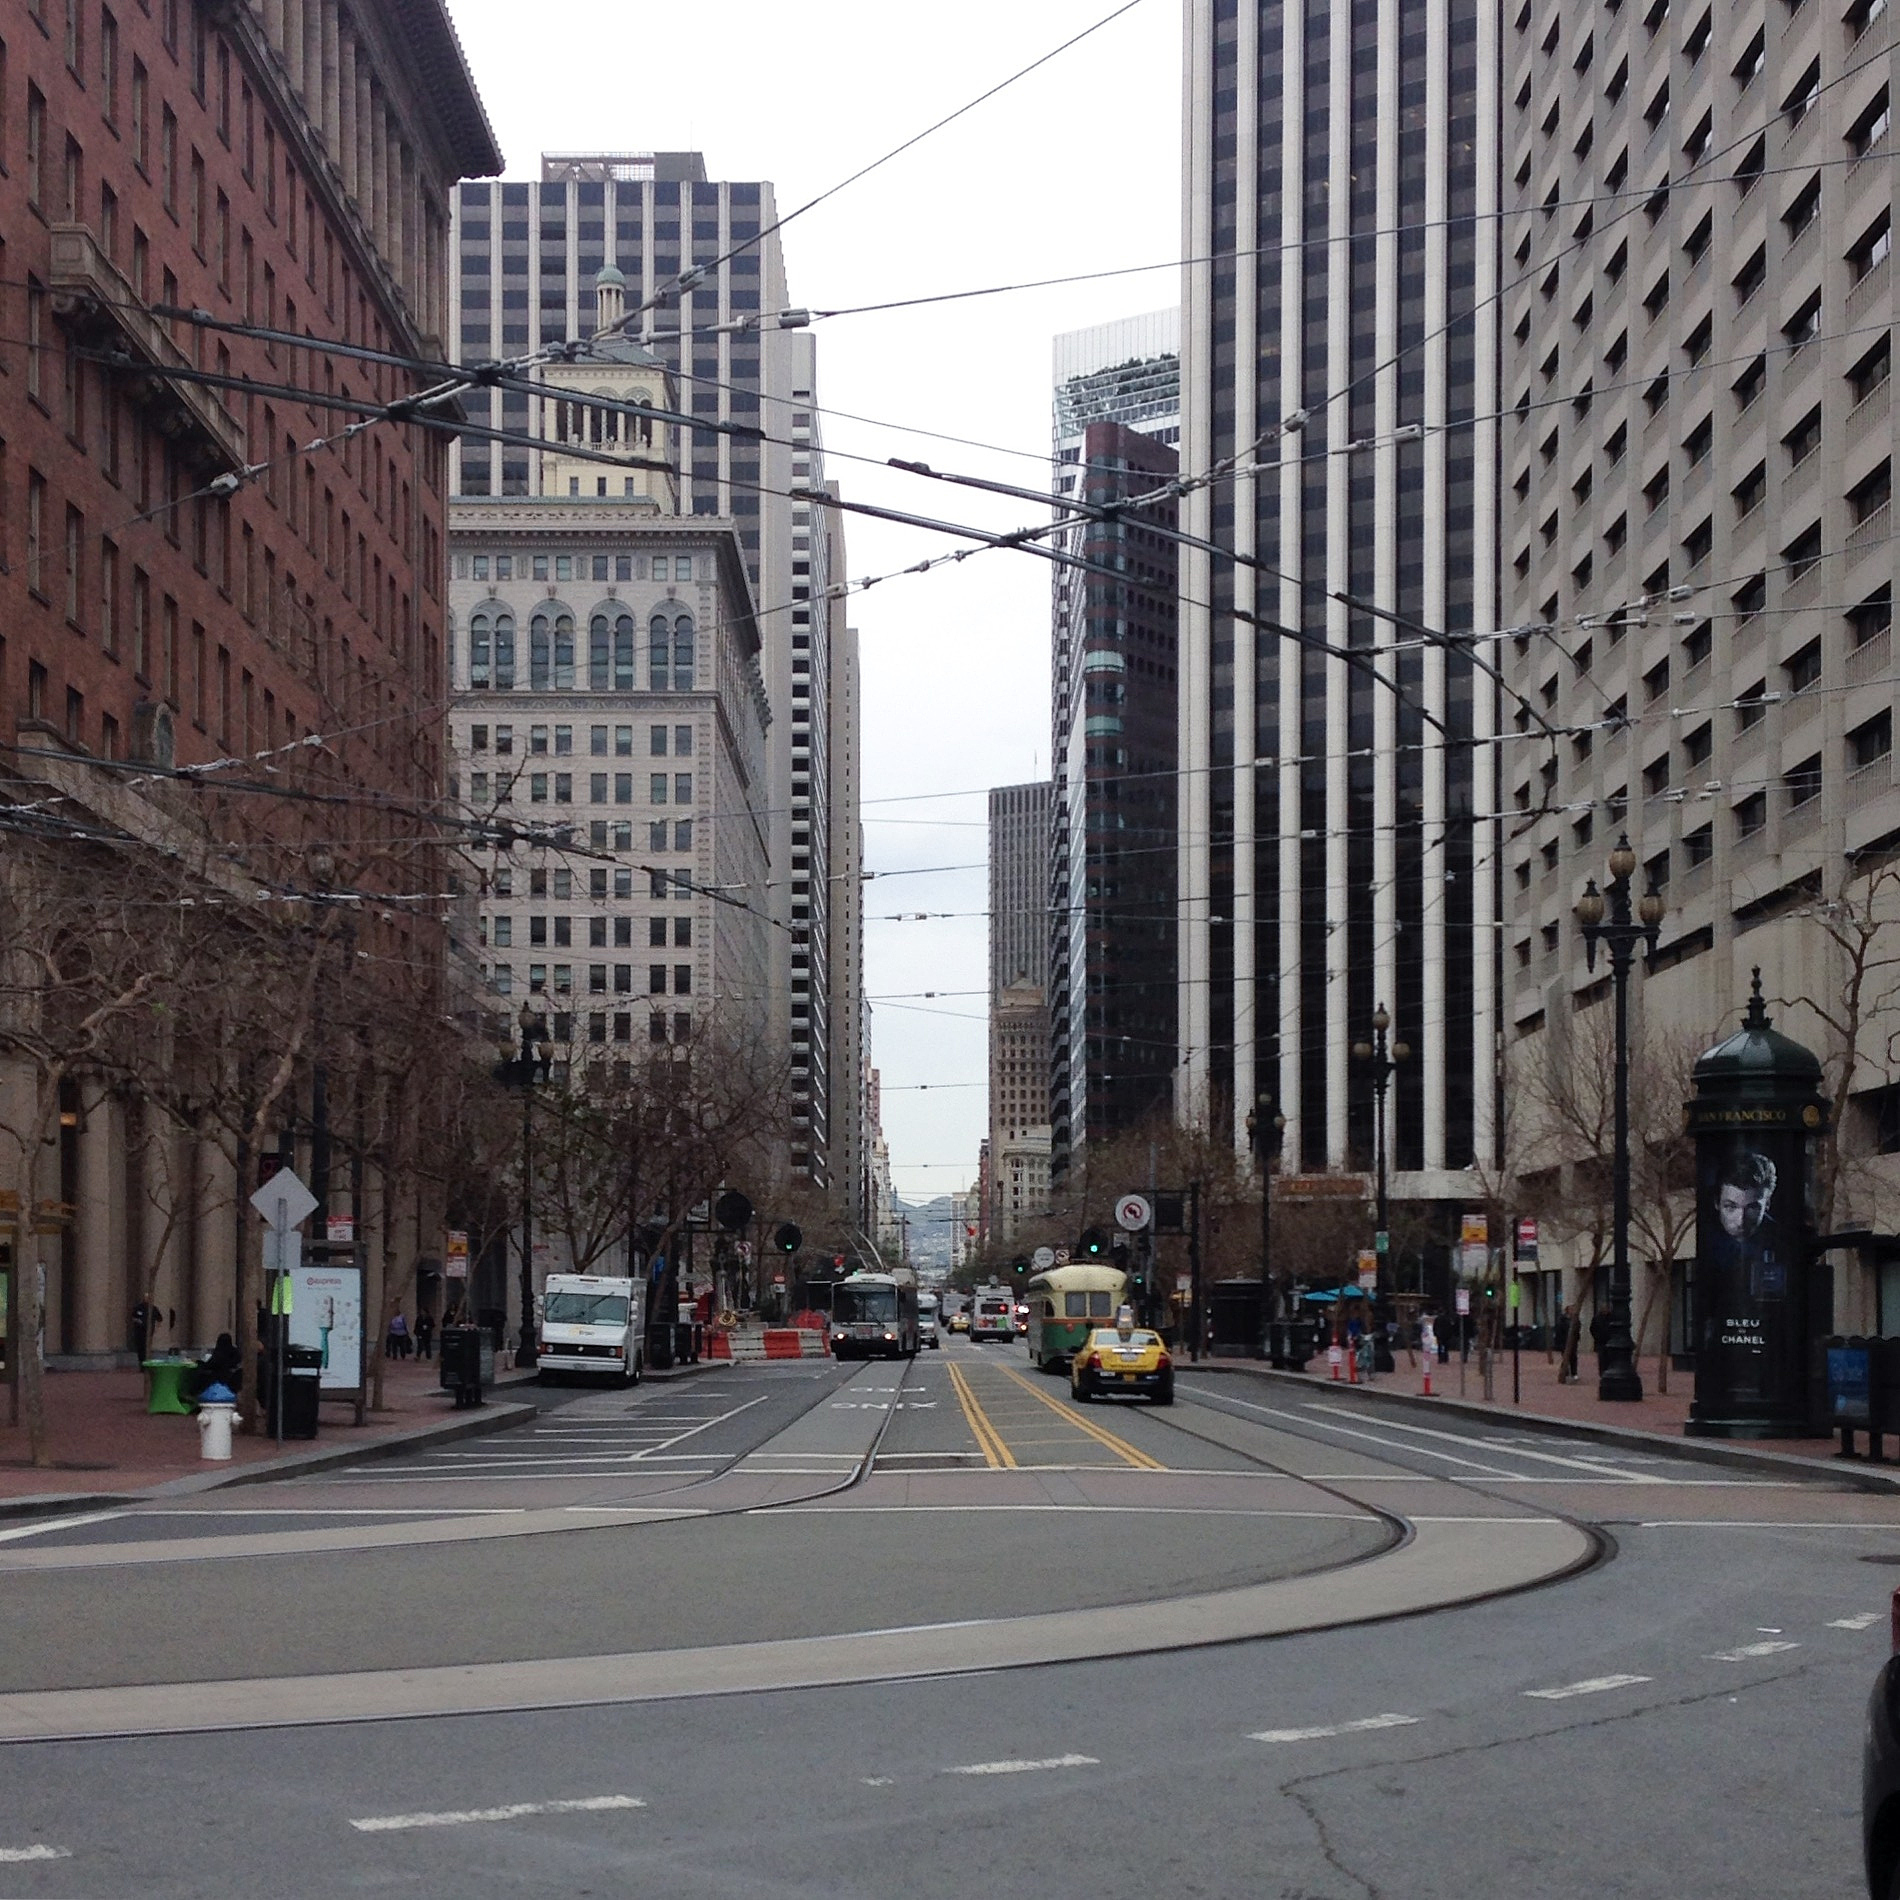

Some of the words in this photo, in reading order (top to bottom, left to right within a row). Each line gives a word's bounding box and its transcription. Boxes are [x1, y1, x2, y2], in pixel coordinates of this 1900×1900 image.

[1717, 1110, 1786, 1121] FRANCISCO
[1726, 1318, 1760, 1327] BLEU
[1721, 1335, 1765, 1344] CHANEL
